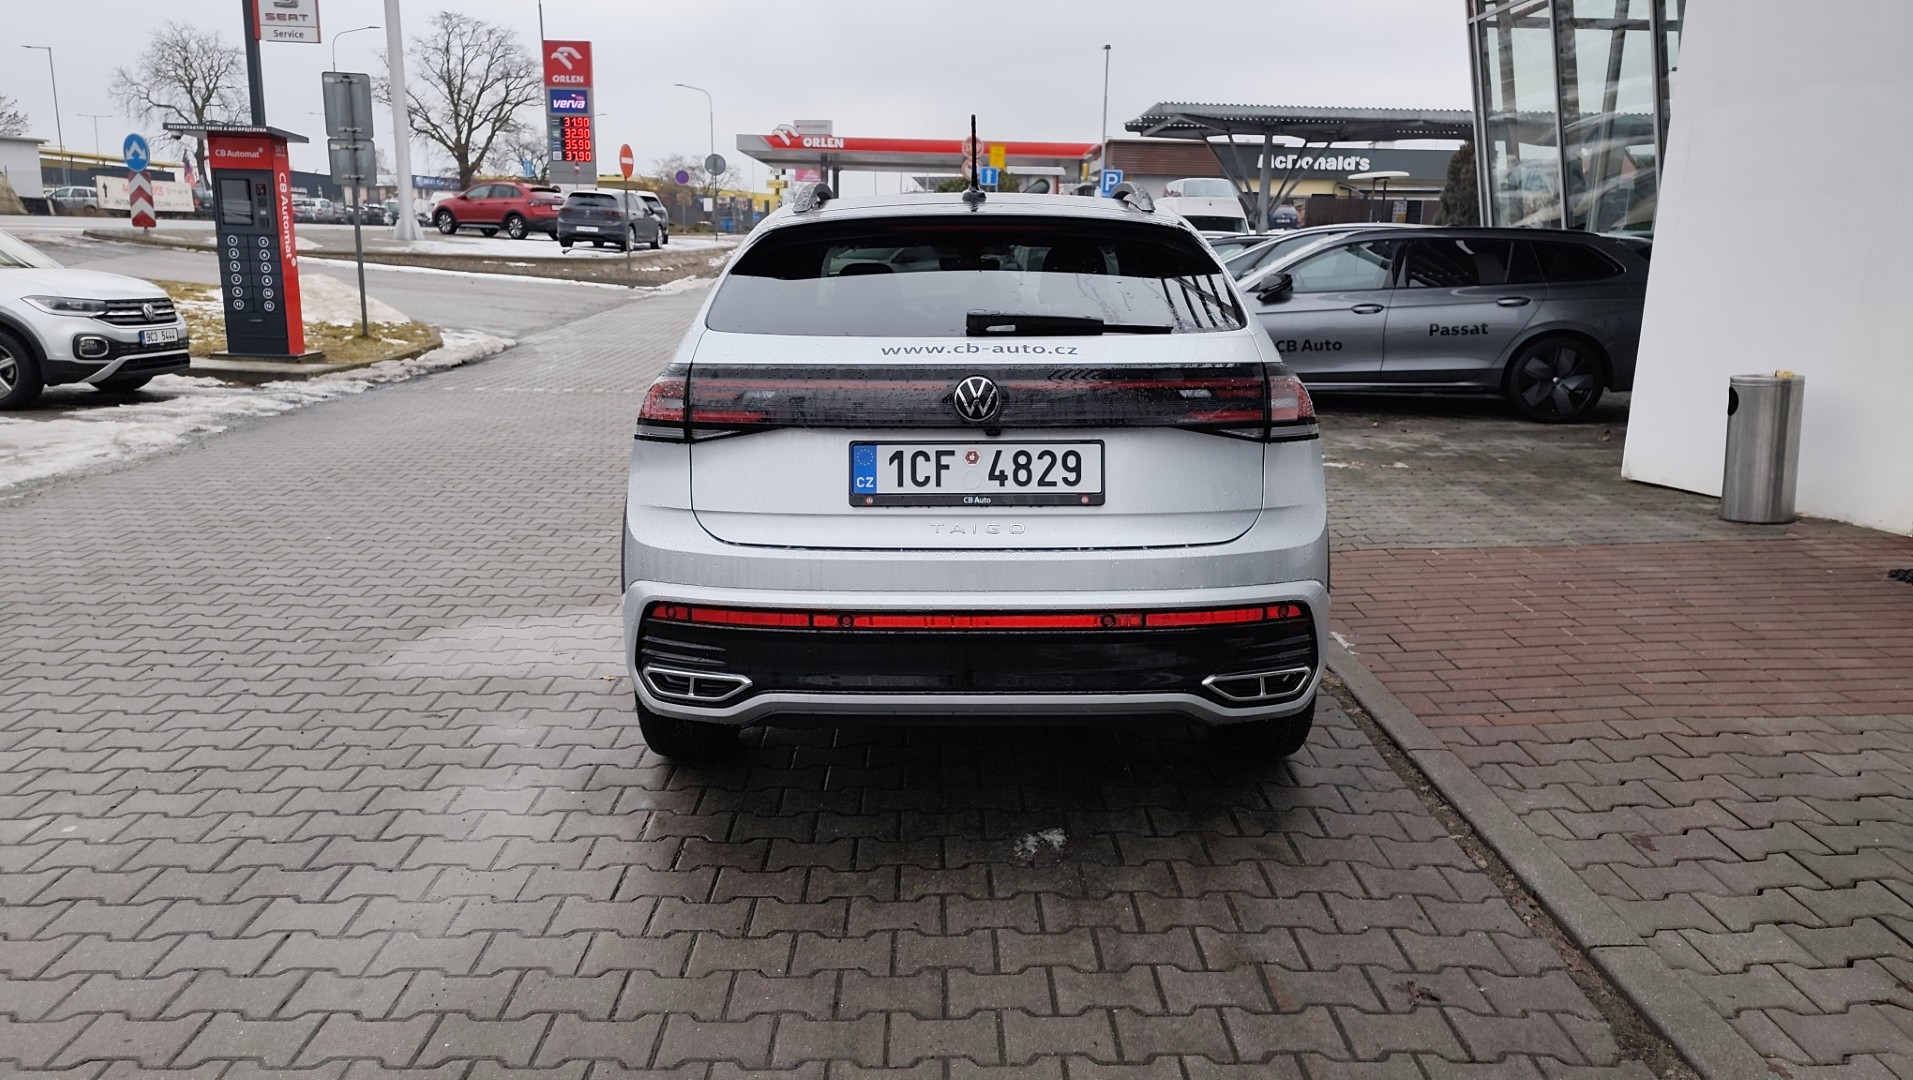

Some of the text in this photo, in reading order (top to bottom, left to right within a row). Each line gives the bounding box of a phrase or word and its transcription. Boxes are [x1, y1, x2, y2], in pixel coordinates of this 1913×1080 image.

[265, 12, 309, 21] SEAT
[273, 29, 304, 38] Service
[552, 74, 584, 83] ORLEN
[553, 99, 586, 109] verva
[802, 137, 844, 148] ORLEN
[964, 142, 983, 152] STP
[215, 149, 260, 158] CB Automat
[1105, 173, 1119, 191] P
[279, 172, 293, 259] CB Automat
[1429, 323, 1489, 337] Passat
[881, 343, 1078, 356] www.cb-auto.cz
[1276, 339, 1343, 353] CB Auto
[888, 450, 1083, 488] 1CF 4829
[856, 477, 874, 488] CZ
[930, 522, 1026, 534] TAIGO
